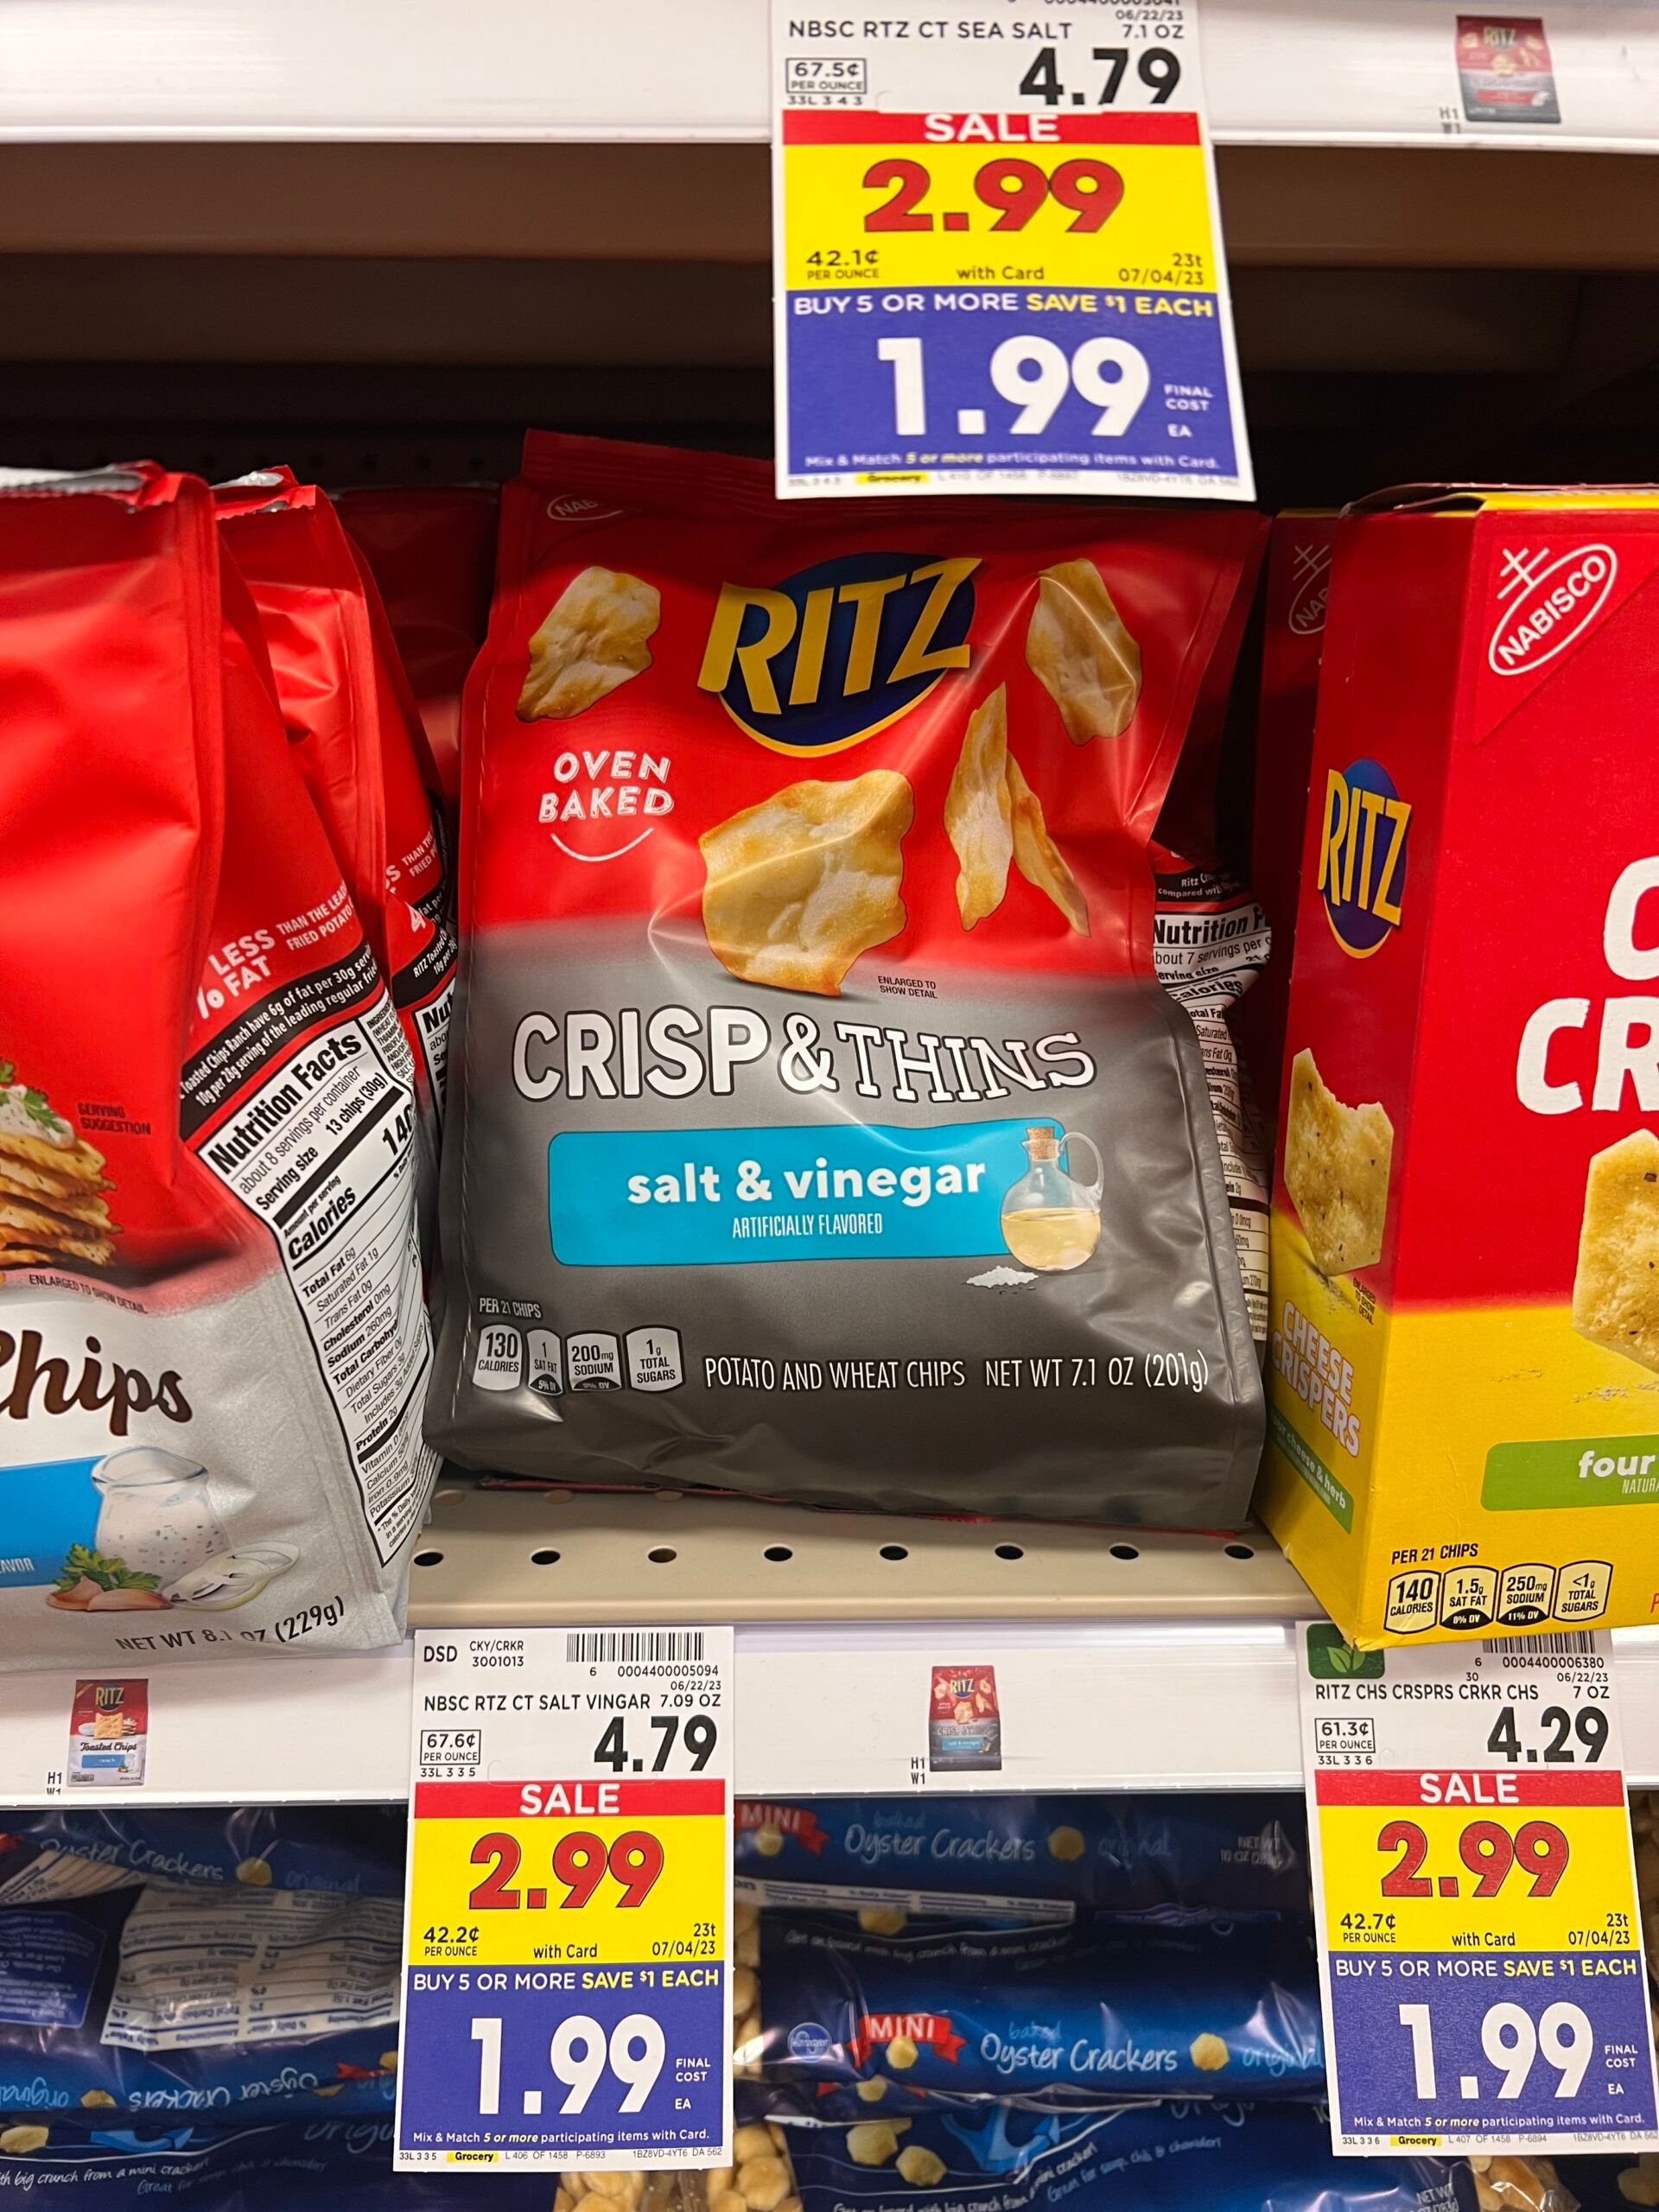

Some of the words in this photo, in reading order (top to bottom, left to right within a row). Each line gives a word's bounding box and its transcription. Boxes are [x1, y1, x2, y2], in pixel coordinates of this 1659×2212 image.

[789, 21, 853, 39] NBSC
[865, 21, 910, 39] RTZ
[918, 22, 949, 39] CT
[958, 22, 1004, 40] SEA
[1013, 23, 1073, 40] SALT
[1122, 24, 1147, 40] 7.1
[1154, 24, 1184, 40] OZ
[793, 61, 860, 78] 67.5¢
[1019, 48, 1181, 105] 4.79
[925, 113, 1061, 142] SALE
[862, 158, 1124, 233] 2.99
[807, 250, 879, 266] 42.1¢
[956, 266, 995, 281] with
[1001, 266, 1045, 281] Card
[1118, 269, 1205, 285] 07/04/23
[794, 296, 850, 315] BUY
[856, 295, 873, 313] 5
[882, 294, 925, 313] OR
[934, 293, 1019, 312] MORE
[1027, 293, 1097, 313] SAVE
[1135, 298, 1213, 318] EACH
[877, 335, 1150, 436] 1.99
[1497, 556, 1607, 665] NABISCO
[698, 557, 983, 715] RITZ
[552, 750, 671, 783] OVEN
[538, 786, 674, 823] BAKED
[1318, 769, 1411, 925] RITZ
[276, 912, 307, 936] THAN
[307, 904, 327, 925] THE
[286, 929, 319, 951] FRIED
[1154, 916, 1248, 945] Nutrition
[208, 929, 276, 976] LESS
[1198, 943, 1240, 963] servings
[222, 955, 271, 996] FAT
[878, 976, 923, 988] ENLARGED
[925, 981, 936, 989] TO
[880, 985, 906, 995] SHOW
[907, 988, 938, 1000] DETAIL
[512, 1004, 771, 1100] CRISP
[778, 1012, 840, 1096] &
[835, 1023, 1097, 1103] THINS
[78, 1103, 125, 1118] SERVING
[207, 1082, 303, 1175] Nutrition
[292, 1033, 361, 1090] Facts
[274, 1114, 314, 1157] servings
[321, 1065, 362, 1109] container
[80, 1117, 151, 1135] SUGGESTION
[256, 1168, 301, 1211] Serving
[298, 1145, 319, 1172] size
[626, 1163, 721, 1205] salt
[737, 1160, 772, 1202] &
[785, 1157, 985, 1209] vinegar
[288, 1186, 356, 1262] Calories
[732, 1214, 815, 1239] ARTIFICIALLY
[817, 1213, 883, 1236] FLAVORED
[480, 1298, 499, 1313] PER
[500, 1300, 511, 1314] 21
[513, 1301, 542, 1319] CHIPS
[323, 1301, 374, 1351] Cholesterol
[327, 1335, 365, 1368] Sodium
[486, 1332, 518, 1358] 130
[572, 1345, 613, 1363] 200mg
[1283, 1300, 1355, 1407] CHEESE
[478, 1360, 518, 1373] CALORIES
[575, 1363, 613, 1376] SODIUM
[640, 1357, 670, 1370] TOTAL
[704, 1357, 775, 1390] POTATO
[782, 1362, 823, 1390] AND
[829, 1361, 899, 1389] WHEAT
[906, 1360, 966, 1388] CHIPS
[985, 1359, 1023, 1387] NET
[1029, 1358, 1064, 1386] WT
[1071, 1358, 1096, 1386] 7.1
[1108, 1357, 1134, 1386] OZ
[1144, 1350, 1210, 1393] (201g)
[637, 1370, 676, 1383] SUGARS
[1272, 1331, 1361, 1458] CRISPERS
[356, 1414, 389, 1451] Protein
[1579, 1451, 1656, 1478] four
[1324, 1473, 1346, 1509] herb
[1392, 1549, 1418, 1565] PER
[1421, 1547, 1434, 1561] 21
[1440, 1543, 1478, 1559] CHIPS
[1396, 1577, 1433, 1604] 140
[1457, 1578, 1484, 1595] 1.5g
[1507, 1576, 1548, 1592] 250mg
[1449, 1597, 1466, 1607] SAT
[1471, 1595, 1487, 1606] FAT
[1506, 1593, 1544, 1604] SODIUM
[1568, 1590, 1596, 1600] TOTAL
[1390, 1602, 1433, 1617] CALORIES
[1561, 1602, 1599, 1613] SUGARS
[115, 1635, 158, 1650] NET
[161, 1630, 198, 1648] WT
[276, 1596, 345, 1643] (229g)
[423, 1645, 458, 1662] DSD
[470, 1640, 524, 1652] CKY/CRKR
[472, 1656, 524, 1667] 3001013
[618, 1664, 719, 1677] 0004400005094
[1503, 1656, 1604, 1669] 0004400006380
[671, 1681, 721, 1691] 06/22/23
[950, 1679, 975, 1694] RITZ
[1316, 1685, 1351, 1700] RITZ
[1356, 1685, 1387, 1700] CHS
[1392, 1685, 1453, 1700] CRSPRS
[1459, 1685, 1502, 1700] CRKR
[1507, 1685, 1539, 1700] CHS
[1573, 1686, 1580, 1699] 7
[1587, 1686, 1610, 1699] OZ
[96, 1687, 124, 1707] RITZ
[424, 1695, 469, 1712] NBSC
[475, 1695, 506, 1711] RTZ
[512, 1694, 533, 1710] CT
[539, 1694, 581, 1710] SALT
[587, 1694, 651, 1709] VINGAR
[660, 1694, 693, 1707] 7.09
[699, 1694, 721, 1707] OZ
[1321, 1722, 1369, 1737] 61.3¢
[1487, 1706, 1610, 1764] 4.29
[80, 1743, 111, 1751] Toasted
[114, 1743, 137, 1753] Chips
[427, 1733, 476, 1749] 67.6¢
[594, 1713, 717, 1772] 4.79
[423, 1751, 442, 1761] PER
[444, 1751, 478, 1761] OUNCE
[911, 1757, 925, 1770] H1
[48, 1772, 62, 1784] H1
[911, 1773, 925, 1784] W1
[1420, 1773, 1520, 1803] SALE
[520, 1783, 620, 1815] SALE
[844, 1825, 922, 1866] Oyster
[930, 1828, 1036, 1862] Crackers
[130, 1840, 224, 1881] Crackers
[1377, 1820, 1569, 1897] 2.99
[468, 1831, 664, 1910] 2.99
[693, 1923, 715, 1937] 23t
[1340, 1913, 1396, 1929] 42.7¢
[423, 1926, 480, 1943] 42.2¢
[1568, 1930, 1630, 1945] 07/04/23
[868, 2017, 937, 2041] MINI
[981, 2032, 1061, 2074] Oyster
[1069, 2040, 1178, 2072] Crackers
[1399, 2002, 1593, 2099] 1.99
[471, 2013, 665, 2114] 1.99
[676, 2058, 711, 2069] FINAL
[676, 2071, 707, 2082] COST
[129, 2086, 231, 2110] Crackers
[675, 2098, 691, 2110] EA
[413, 2133, 433, 2142] Mix
[435, 2133, 443, 2142] &
[446, 2133, 480, 2143] Match
[483, 2133, 491, 2142] 5
[541, 2131, 614, 2145] participating
[618, 2131, 649, 2141] items
[652, 2130, 676, 2140] with
[679, 2129, 709, 2140] Card.
[455, 2152, 494, 2163] Grocery
[576, 2151, 606, 2159] P-6893
